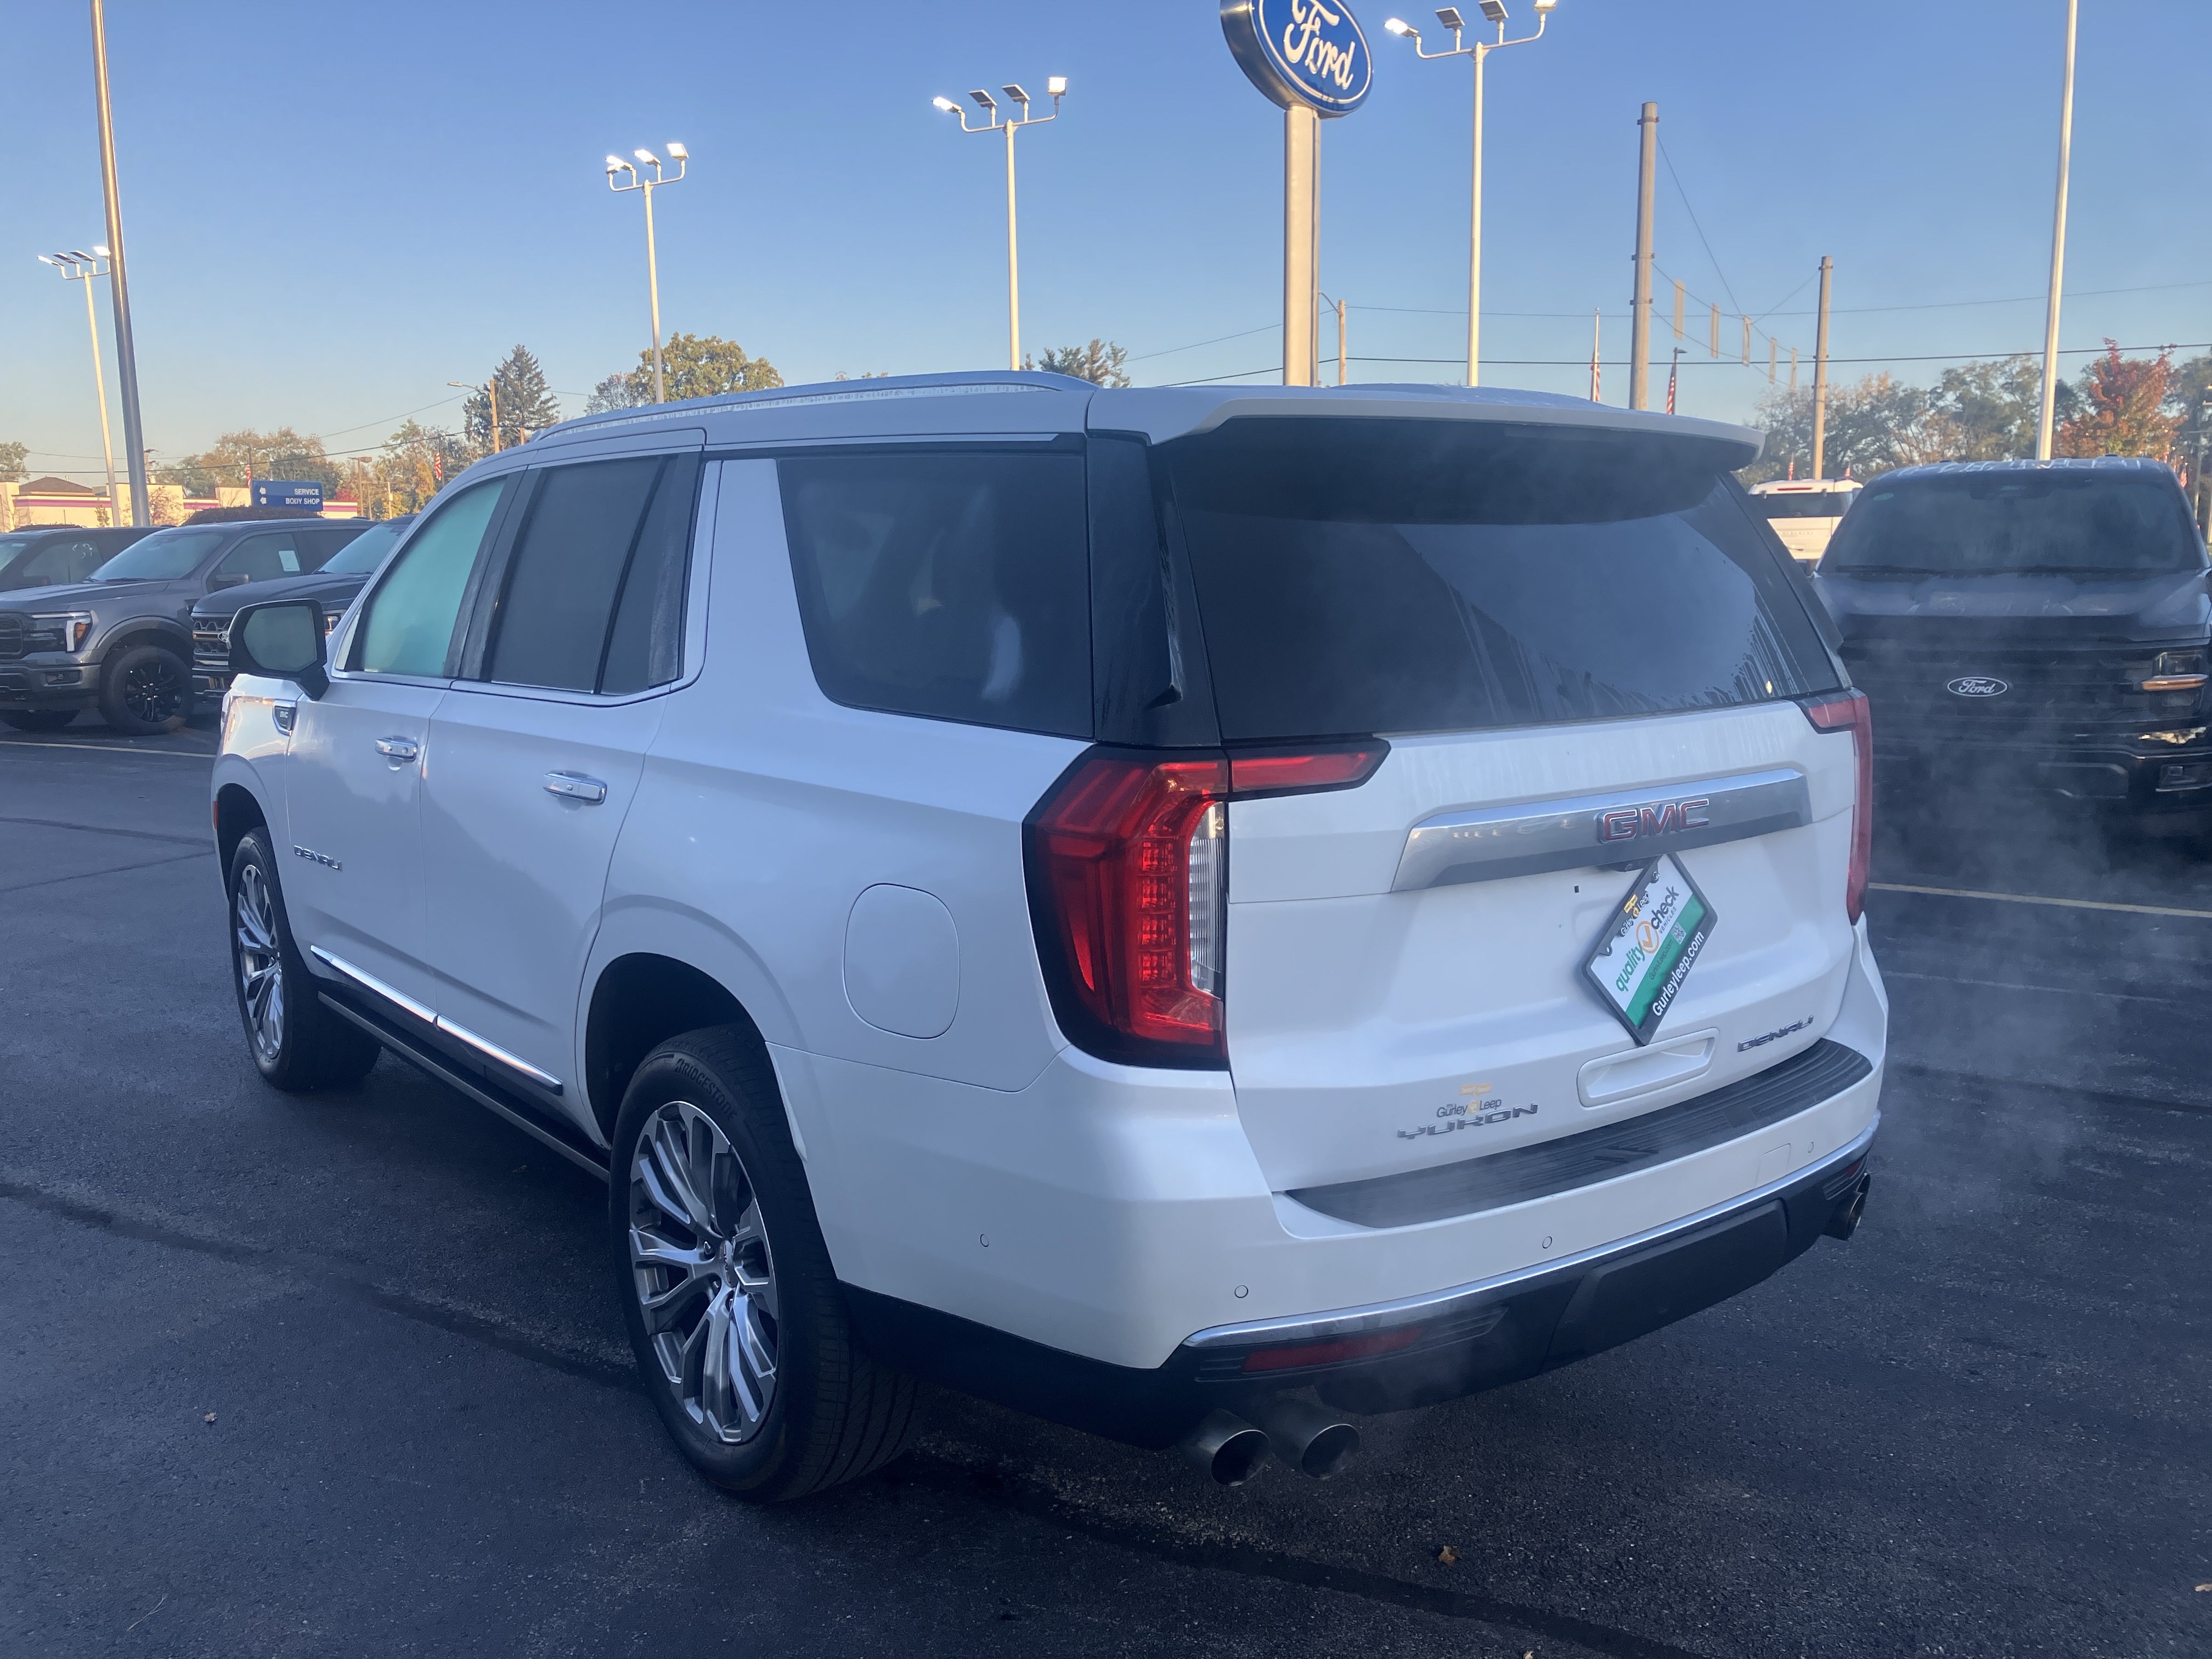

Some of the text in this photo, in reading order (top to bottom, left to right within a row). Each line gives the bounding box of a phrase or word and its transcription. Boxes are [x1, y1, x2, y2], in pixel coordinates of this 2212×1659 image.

[1284, 0, 1356, 90] Ford
[1958, 679, 1996, 693] Ford
[1599, 798, 1709, 843] GMC
[294, 845, 342, 872] DENALI
[1616, 885, 1679, 992] quality check
[1658, 906, 1677, 934] VEHICLES
[1652, 931, 1705, 1016] Gurleyleep.com
[1737, 1014, 1814, 1052] DENALI
[1397, 1102, 1538, 1139] YUKON
[1436, 1098, 1502, 1118] Gurley Leep
